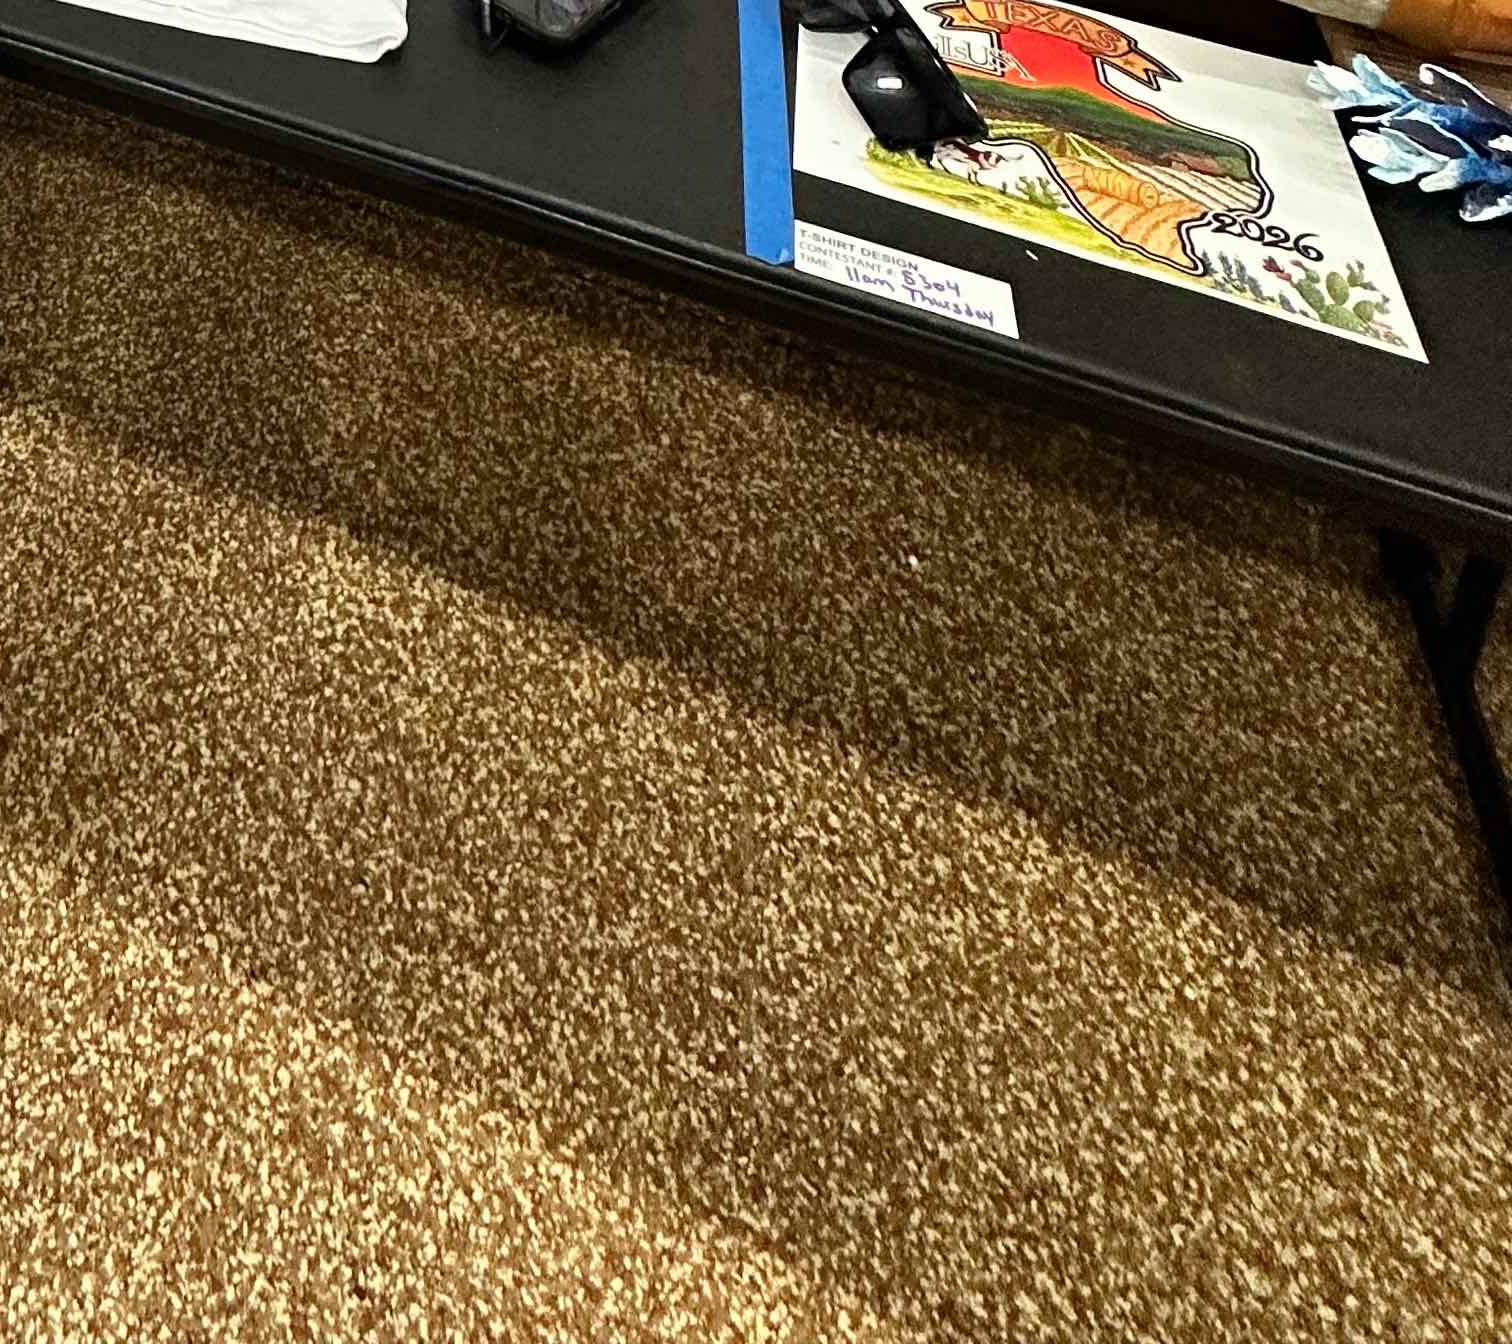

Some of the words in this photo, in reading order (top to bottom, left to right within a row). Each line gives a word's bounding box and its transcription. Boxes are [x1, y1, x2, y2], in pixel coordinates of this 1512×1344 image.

[799, 228, 855, 251] T-SHIRT
[860, 247, 918, 272] DESIGN
[799, 241, 882, 272] CONTESTANT
[1211, 211, 1324, 263] 2026
[901, 283, 994, 327] Thursday
